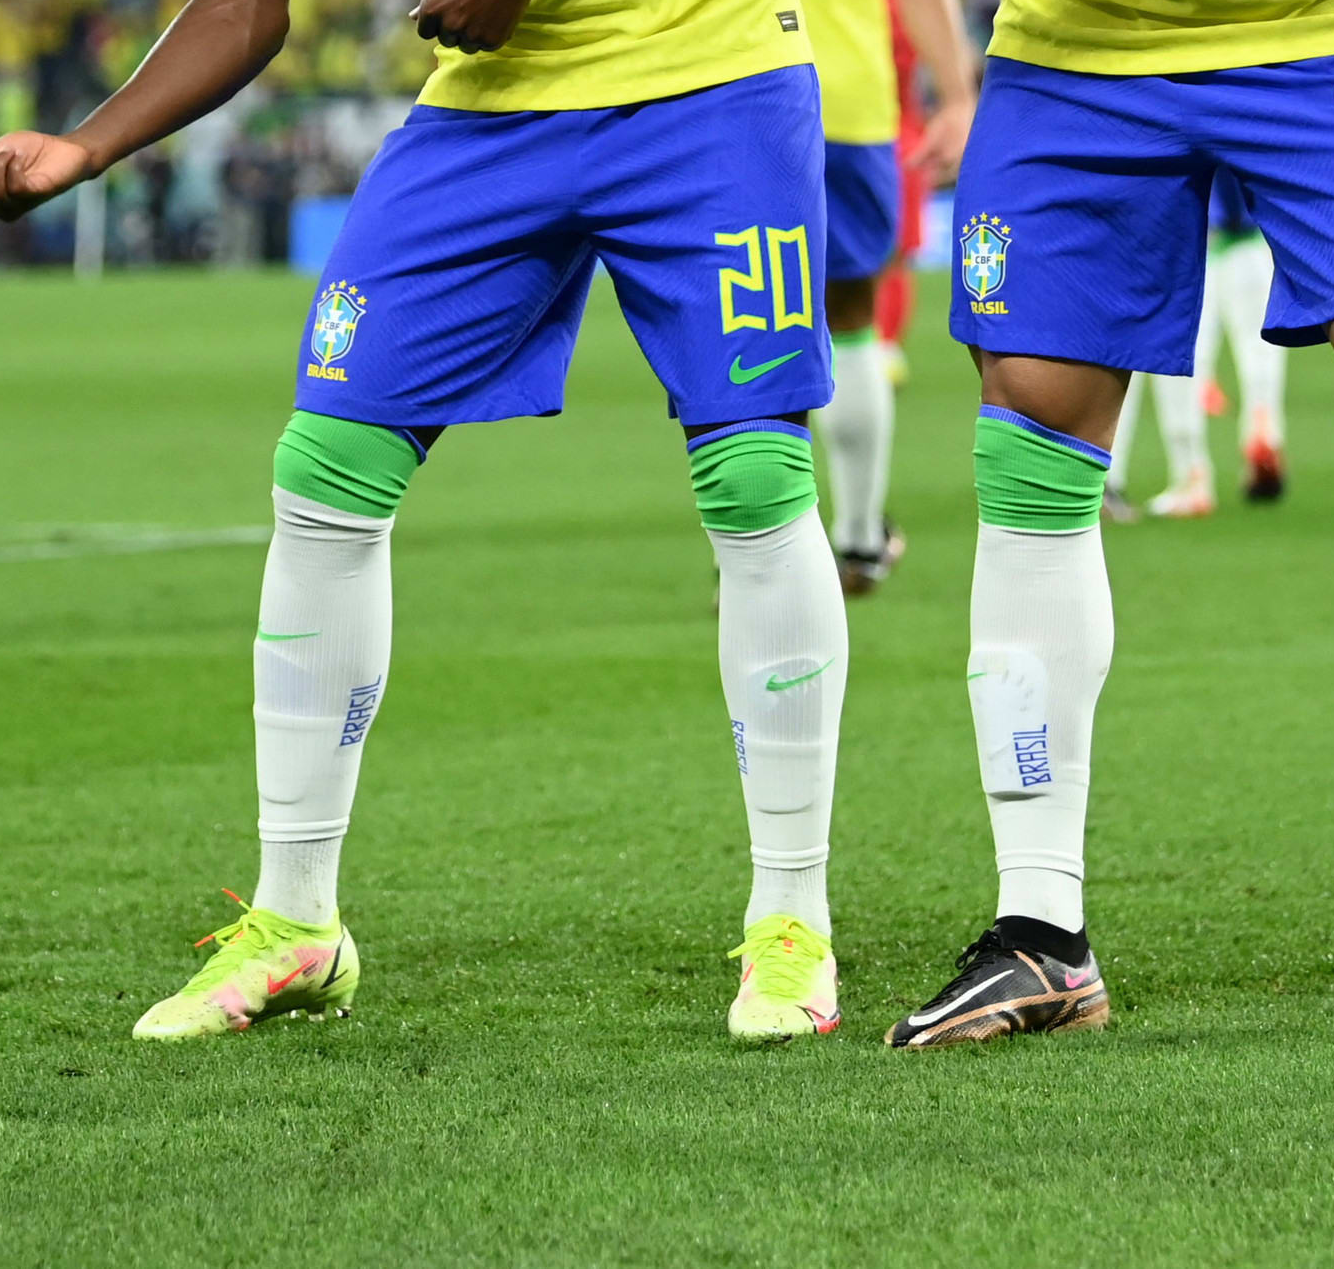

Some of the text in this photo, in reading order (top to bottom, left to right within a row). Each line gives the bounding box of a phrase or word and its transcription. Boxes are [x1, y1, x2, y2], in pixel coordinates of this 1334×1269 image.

[975, 255, 991, 264] CBF
[714, 225, 813, 335] 20
[970, 301, 1009, 314] RASIL
[324, 321, 340, 330] CBF
[307, 363, 349, 381] BRASIL
[339, 674, 381, 747] BRASIL
[1012, 724, 1052, 787] BRASIL
